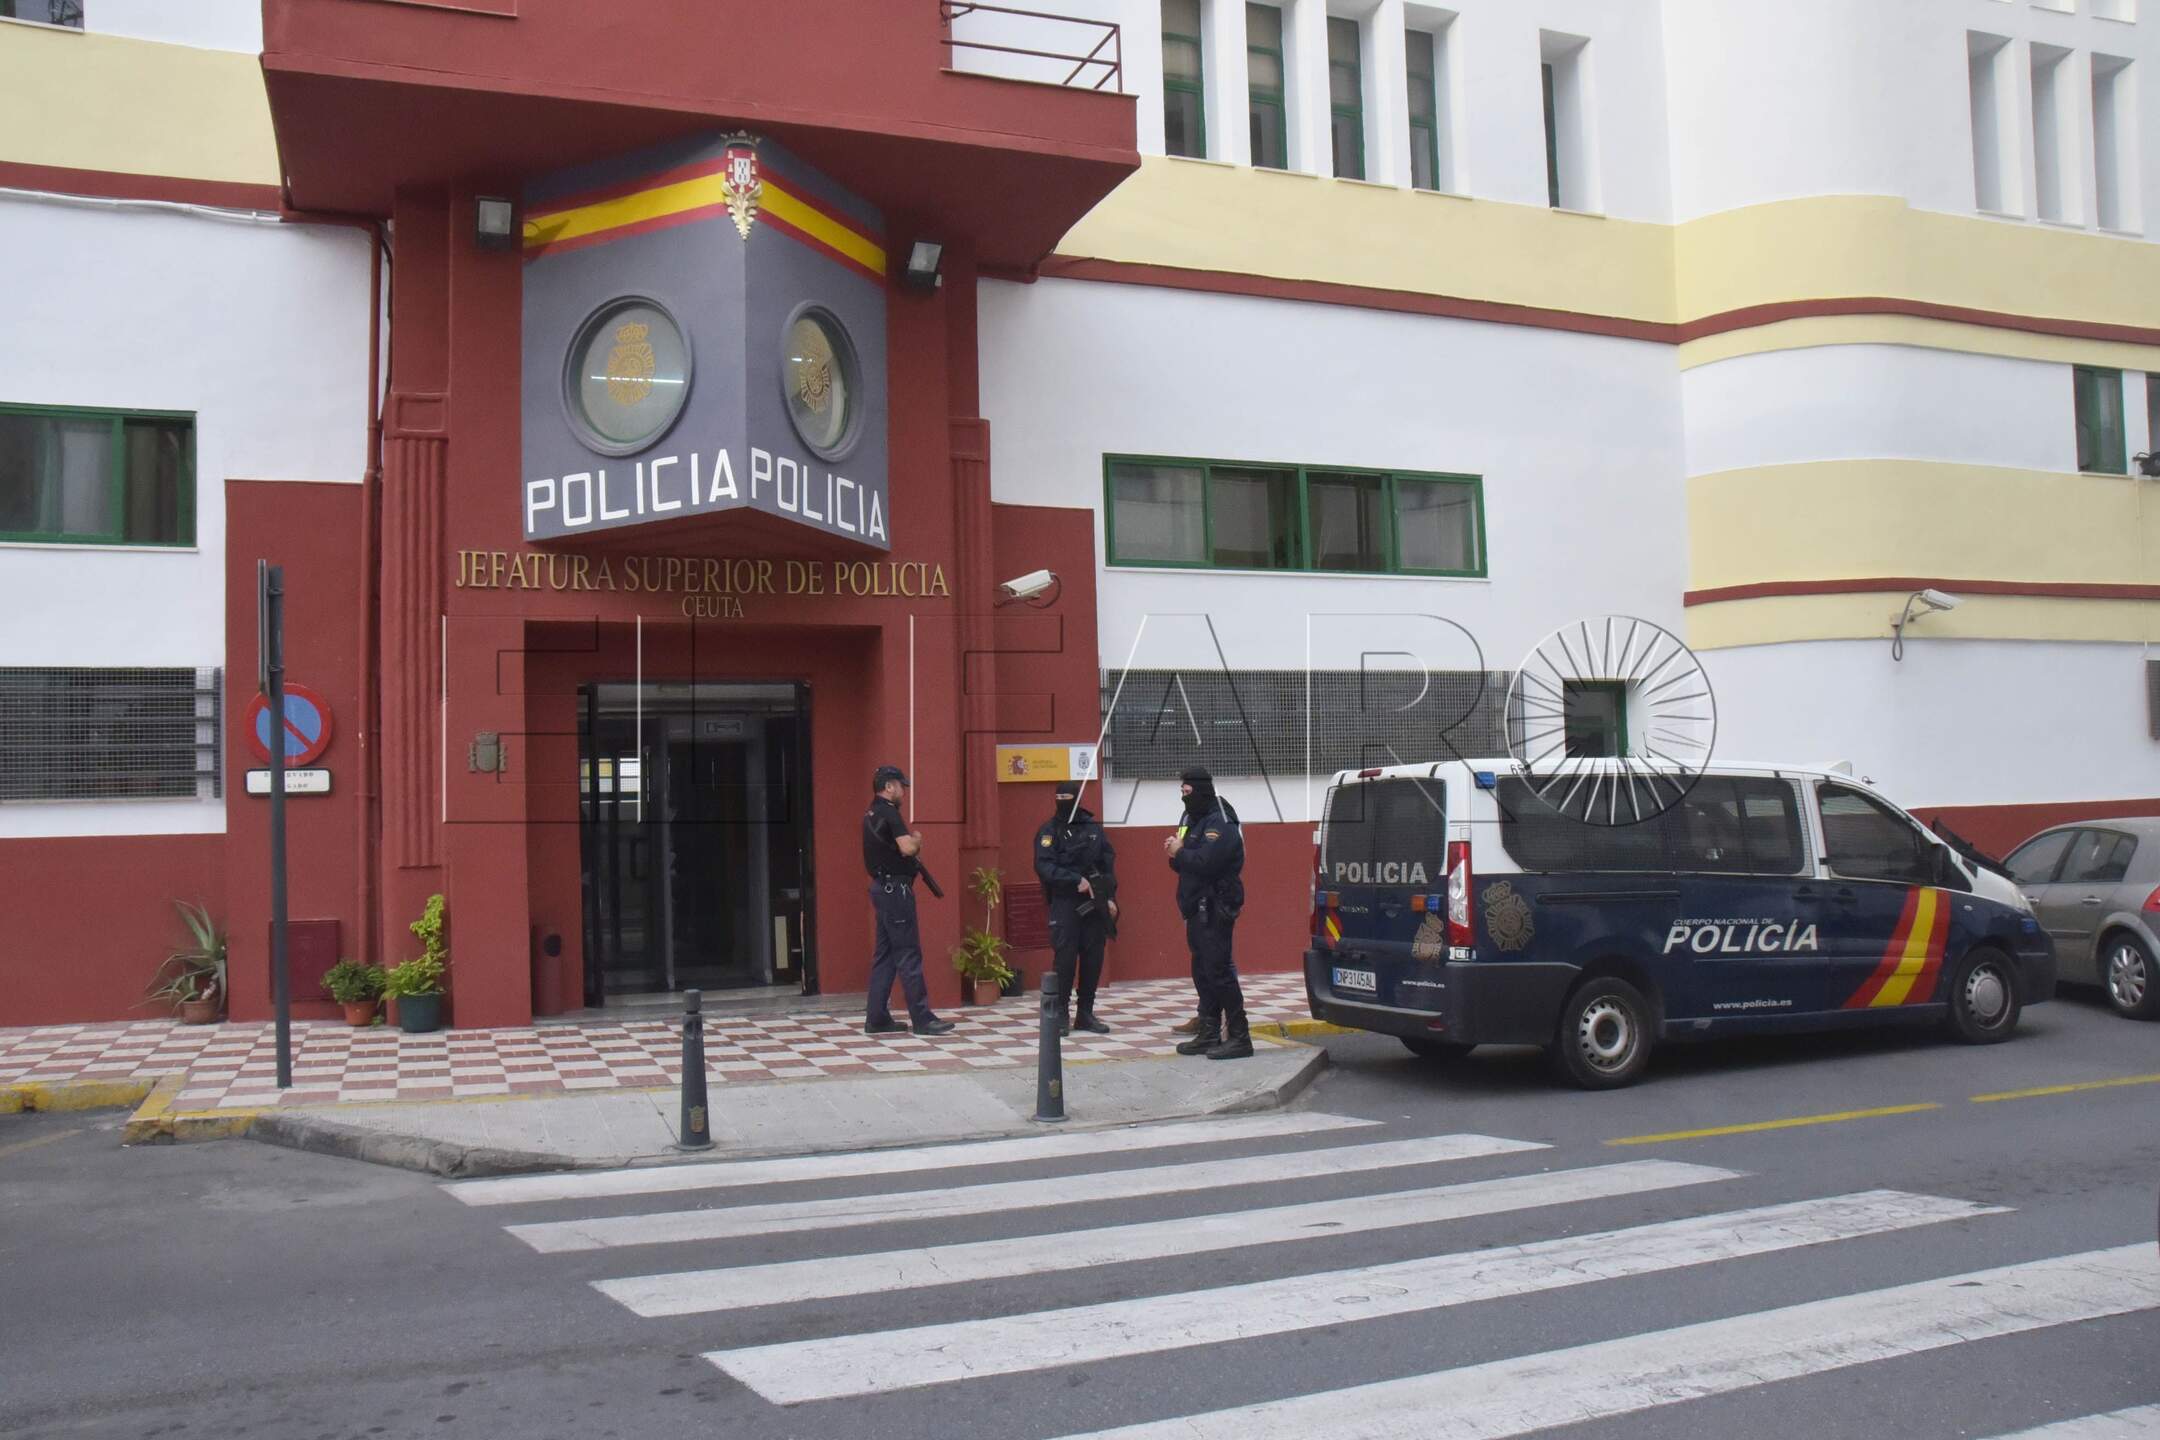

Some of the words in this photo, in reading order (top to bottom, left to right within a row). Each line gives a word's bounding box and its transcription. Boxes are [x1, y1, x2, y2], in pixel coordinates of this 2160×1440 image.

[527, 448, 738, 533] POLICIA
[751, 447, 886, 542] POLICIA
[455, 550, 616, 591] JEFATURA
[623, 556, 776, 596] SUPERIOR
[785, 560, 825, 596] DE
[833, 561, 951, 598] POLICIA
[681, 596, 745, 619] CEUTA
[1335, 862, 1428, 884] POLICIA
[1663, 919, 1818, 954] POLICÍA
[1673, 918, 1712, 926] CUERPO
[1713, 918, 1759, 926] NACIONAL
[1713, 998, 1792, 1010] www.policia.es
